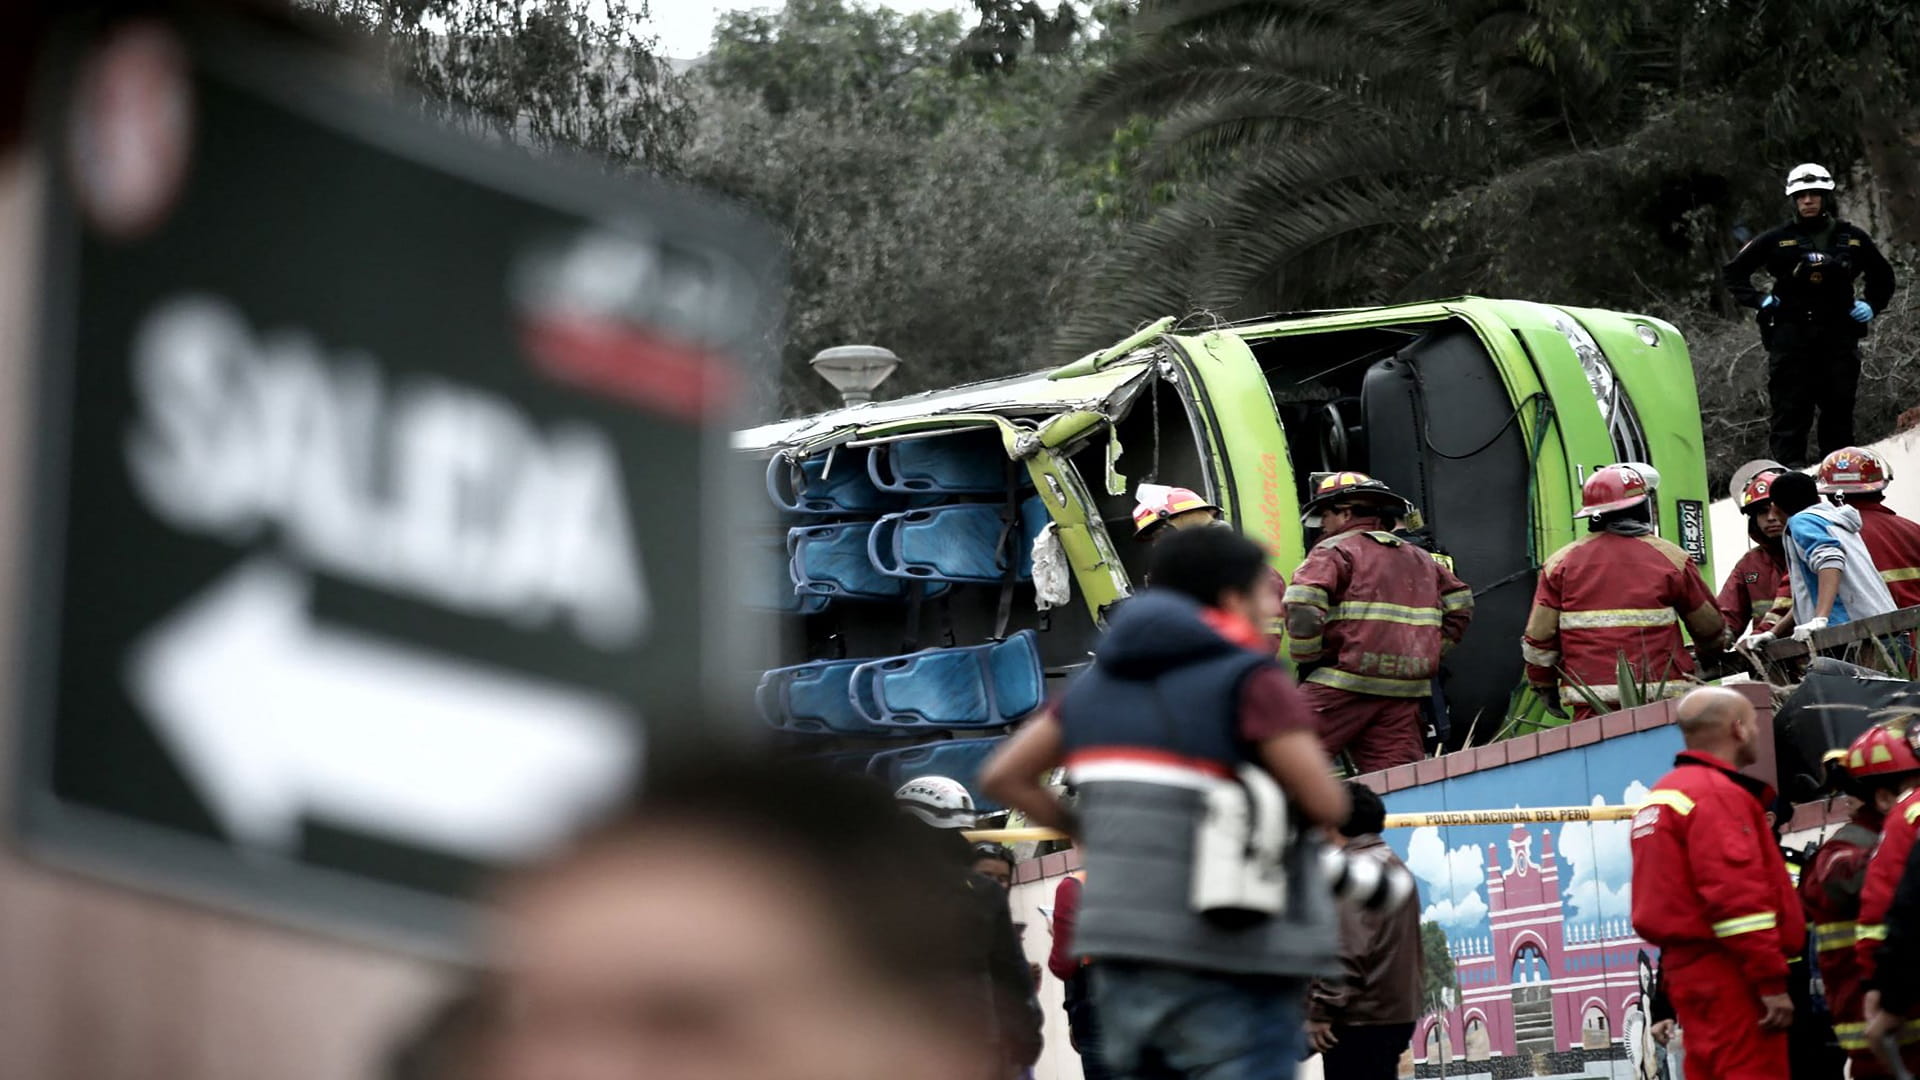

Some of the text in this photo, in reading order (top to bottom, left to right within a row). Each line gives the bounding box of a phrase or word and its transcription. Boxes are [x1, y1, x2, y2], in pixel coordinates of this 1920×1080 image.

[128, 298, 650, 648] SALIDA
[1360, 651, 1430, 676] PERU
[1425, 813, 1471, 825] POLICIA
[1473, 811, 1533, 823] NACIONAL
[1536, 810, 1557, 822] DEL
[1560, 808, 1590, 820] PERU
